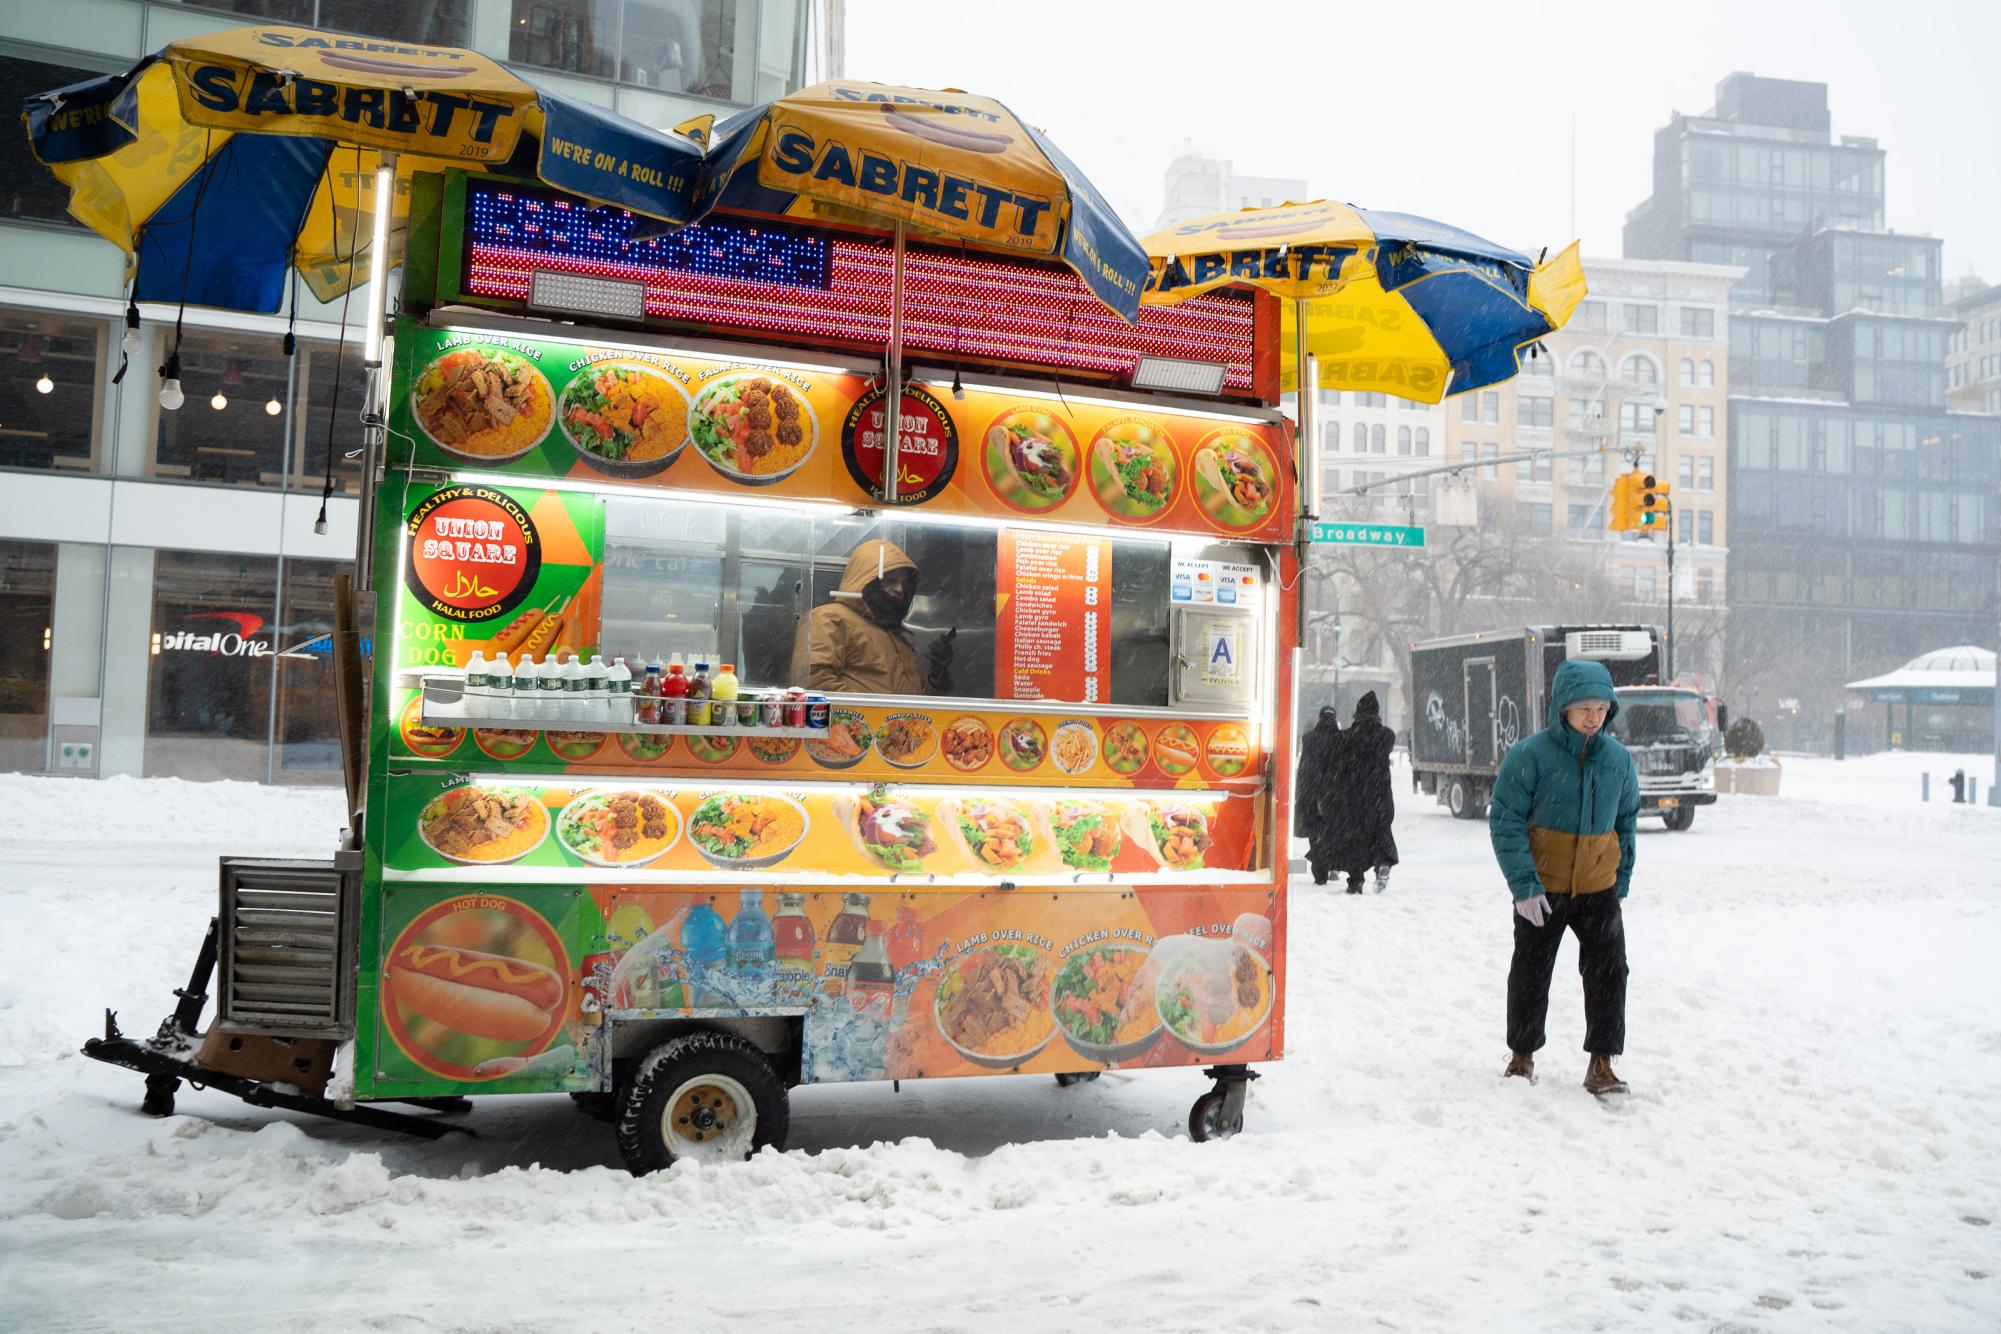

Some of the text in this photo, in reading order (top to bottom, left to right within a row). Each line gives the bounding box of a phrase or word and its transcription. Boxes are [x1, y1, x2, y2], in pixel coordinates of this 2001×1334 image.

[254, 31, 465, 60] SABRETT
[190, 62, 514, 144] SABRETT
[458, 144, 489, 158] 2019
[552, 136, 684, 193] WE'RE ON A ROLL !!!
[771, 125, 1050, 236] SABRETT
[1005, 235, 1032, 246] 2019
[1103, 263, 1122, 288] ROLL
[436, 335, 542, 361] LAMB OVER RICE
[568, 350, 691, 385] CHICKEN OVER RICE
[783, 370, 811, 392] RICE
[871, 411, 928, 434] UION
[906, 388, 951, 438] DELICIOUS
[862, 431, 938, 455] SQARE
[900, 490, 927, 502] FOOD
[408, 487, 533, 545] HEALTHY & DELICIOUS
[434, 516, 504, 541] UNION
[1312, 525, 1405, 545] Broadway
[422, 539, 516, 564] SQUARE
[444, 568, 499, 598] حلال
[432, 600, 502, 619] HALAL FOOD
[401, 622, 466, 641] CORN
[408, 647, 457, 665] DOG
[1211, 637, 1232, 664] A
[452, 898, 506, 911] HOT DOG
[956, 929, 1053, 953] LAMB OVER RICE
[1058, 930, 1109, 959] CHICKEN
[1112, 929, 1142, 941] OVER
